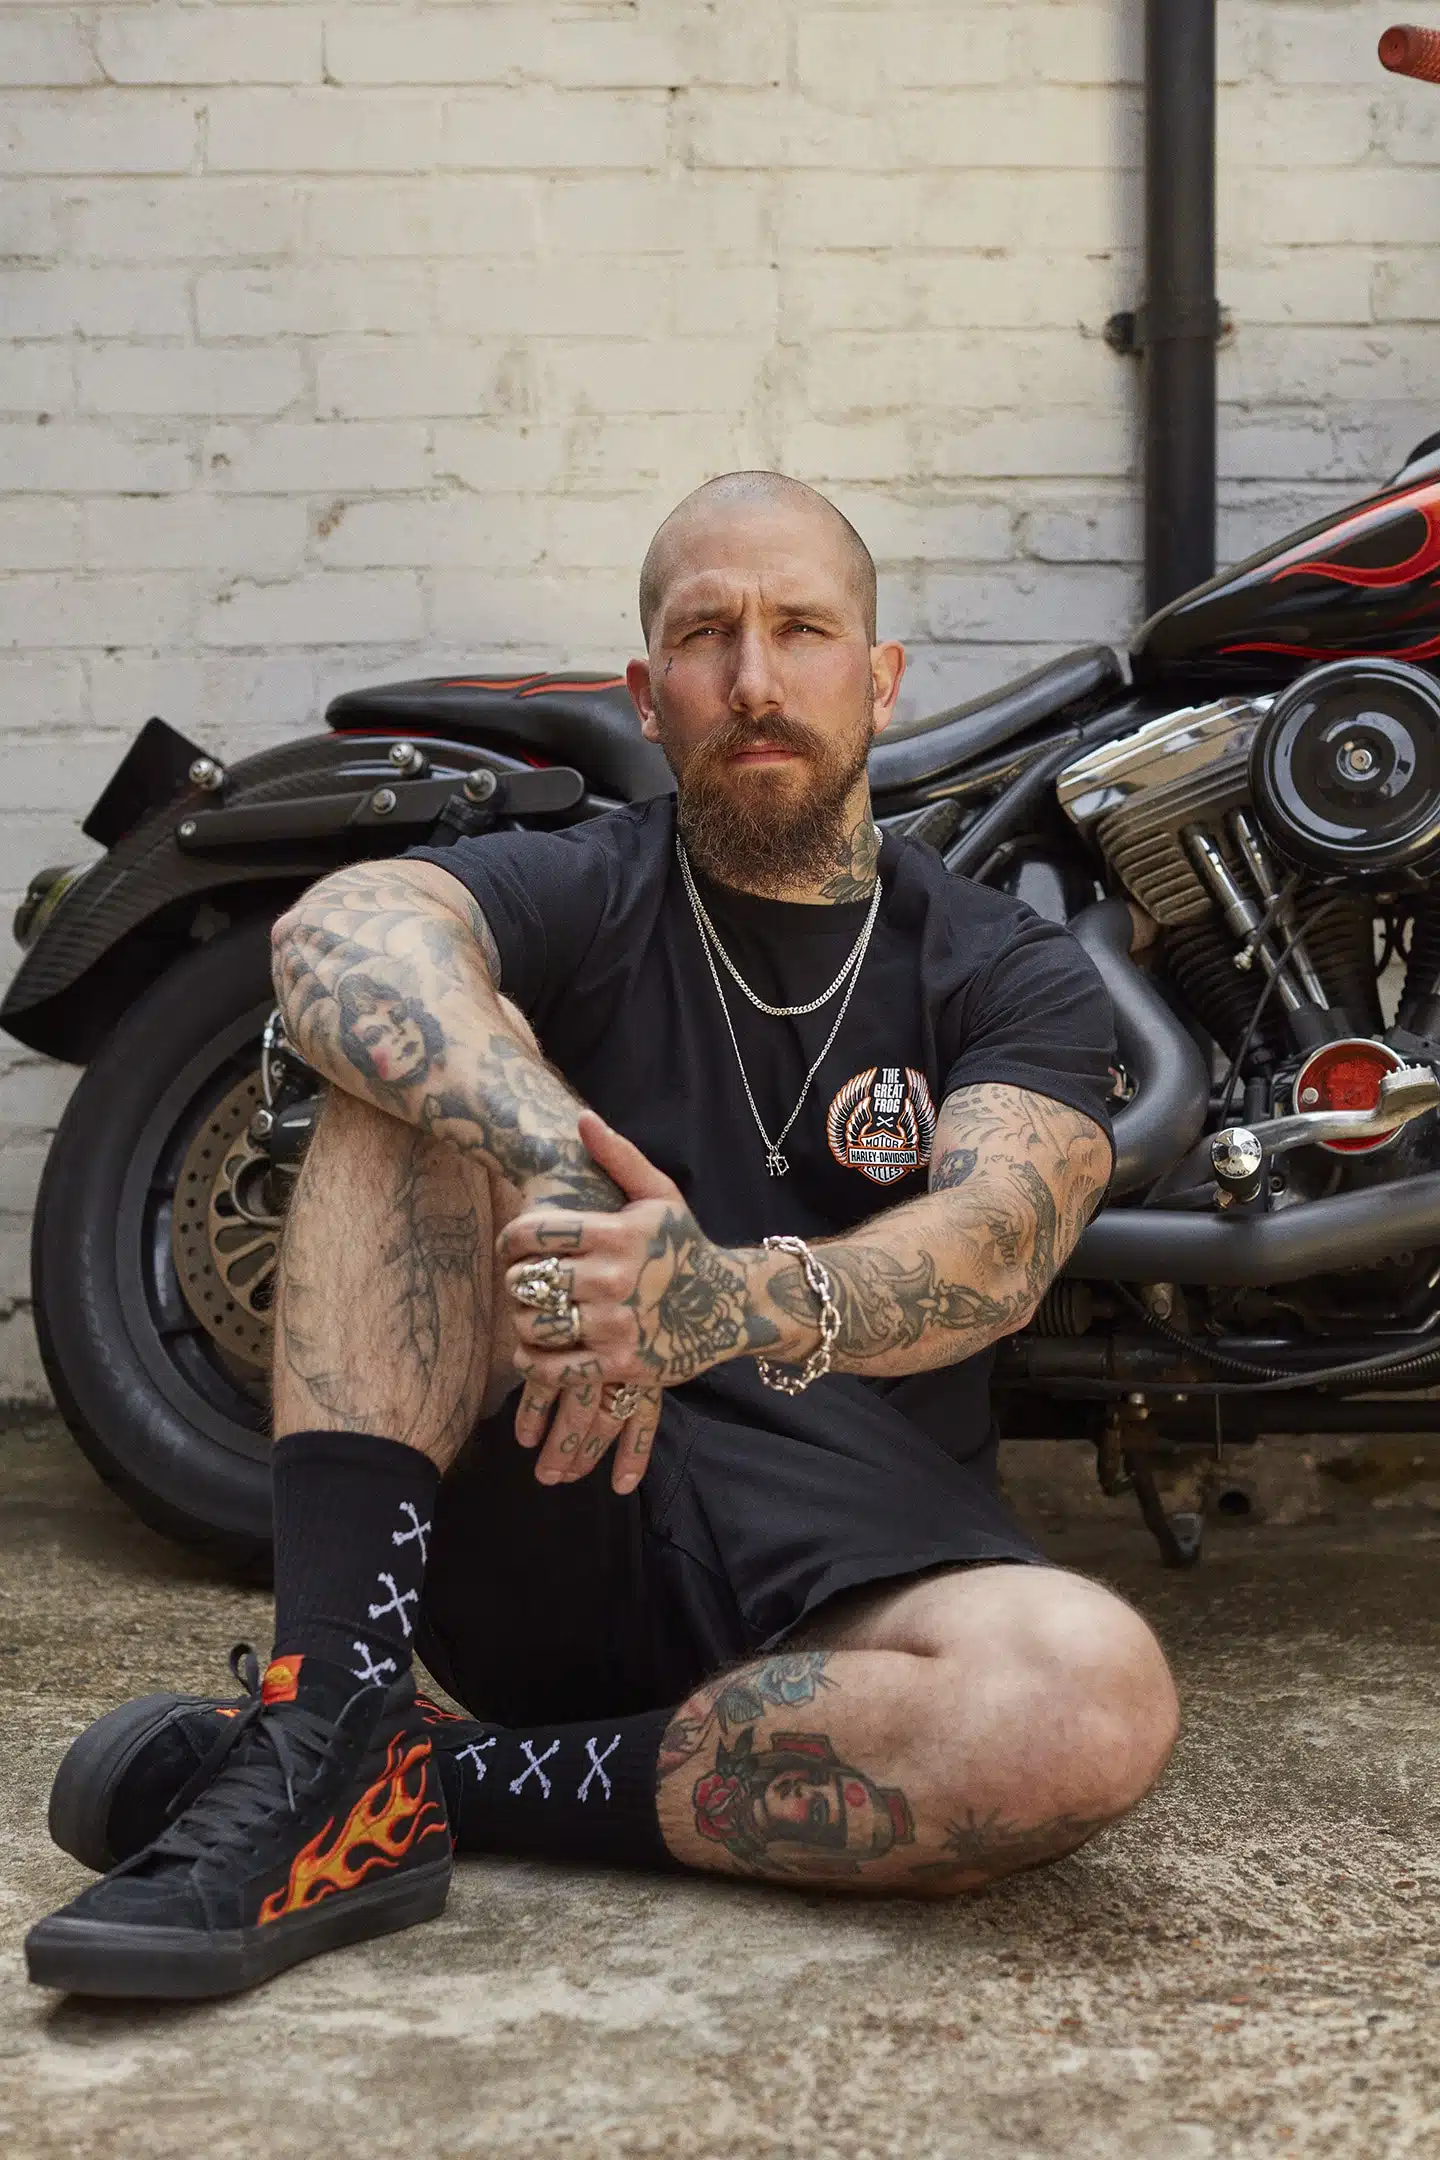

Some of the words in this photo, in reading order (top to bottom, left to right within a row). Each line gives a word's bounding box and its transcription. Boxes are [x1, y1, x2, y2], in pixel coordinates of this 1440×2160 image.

[882, 1068, 900, 1083] THE
[873, 1083, 905, 1099] GREAT
[873, 1098, 901, 1113] FROG
[865, 1134, 899, 1148] MOTOR
[850, 1150, 916, 1164] HARLEY-DAVIDSON
[866, 1165, 901, 1181] CYCLES
